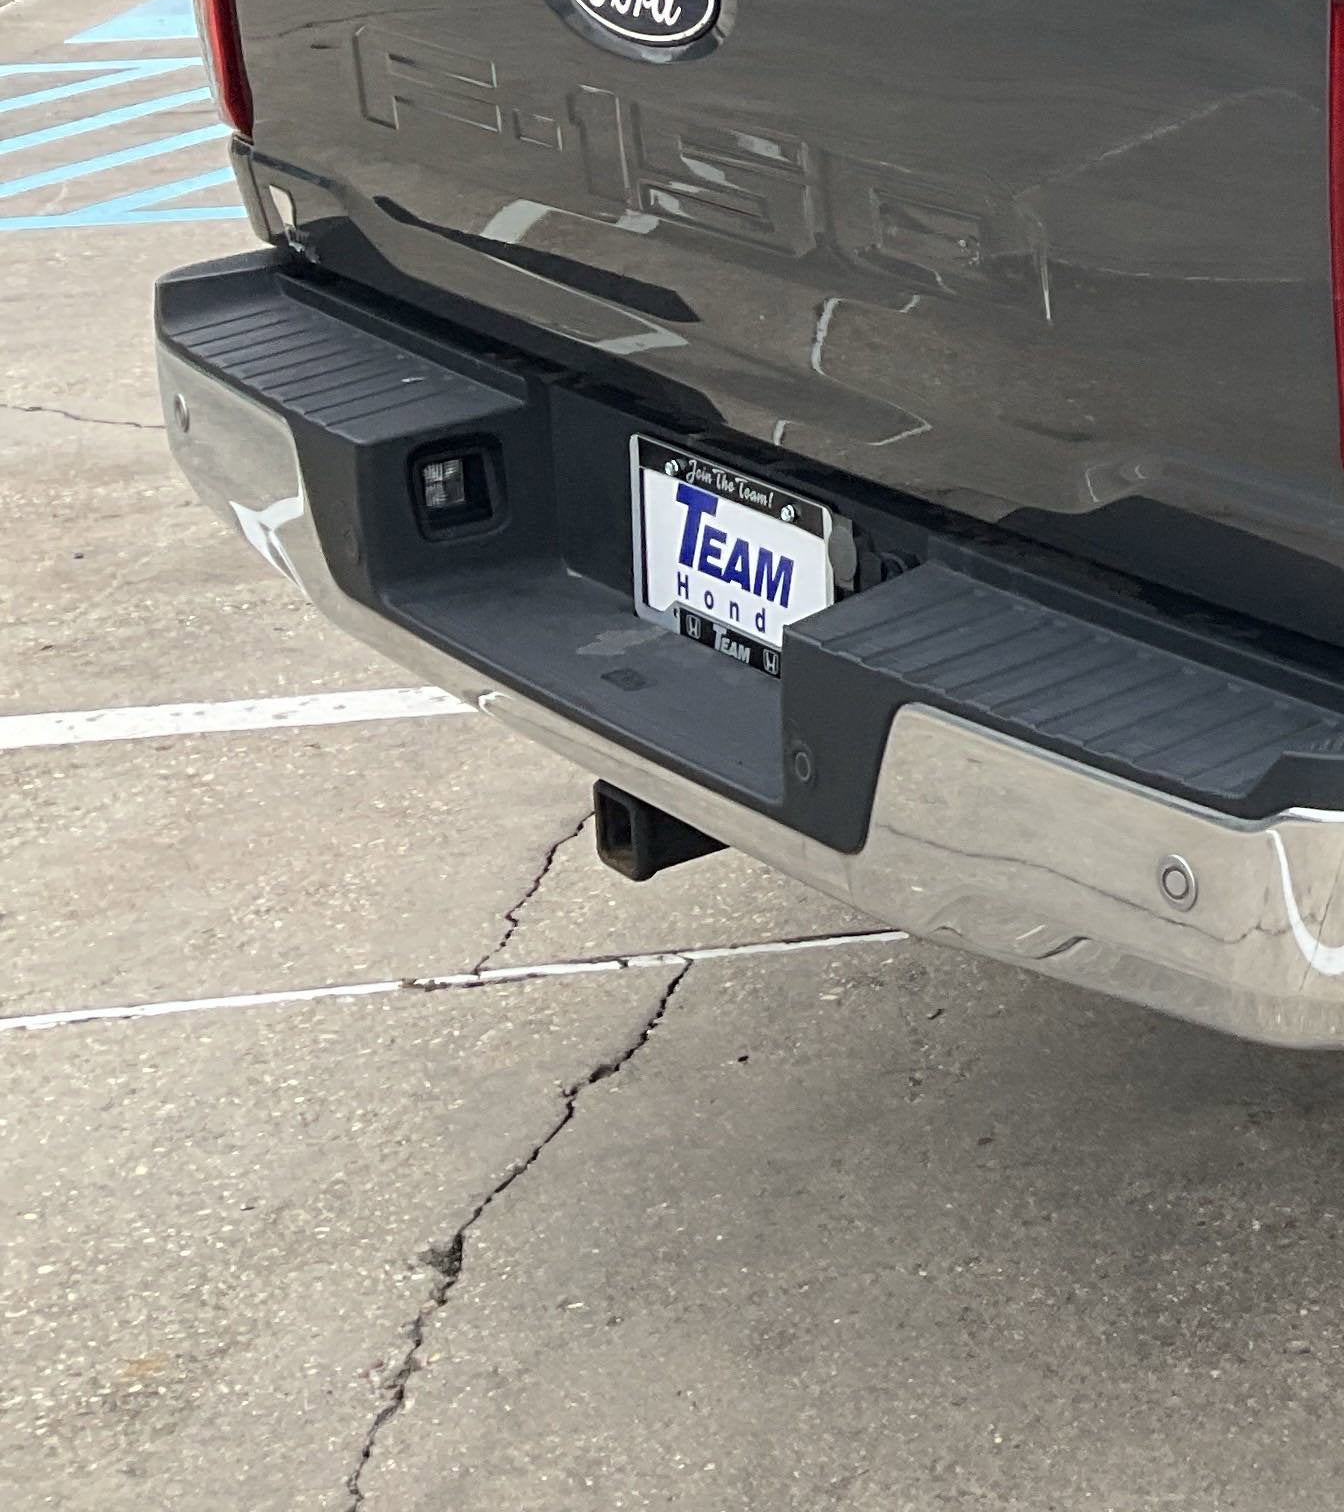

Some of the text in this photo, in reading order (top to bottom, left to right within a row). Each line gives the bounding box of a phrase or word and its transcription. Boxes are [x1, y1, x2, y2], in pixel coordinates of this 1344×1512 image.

[686, 459, 774, 509] Join The Team!
[675, 482, 795, 609] TEAM
[677, 571, 767, 634] Hond
[713, 623, 751, 664] TEAM
